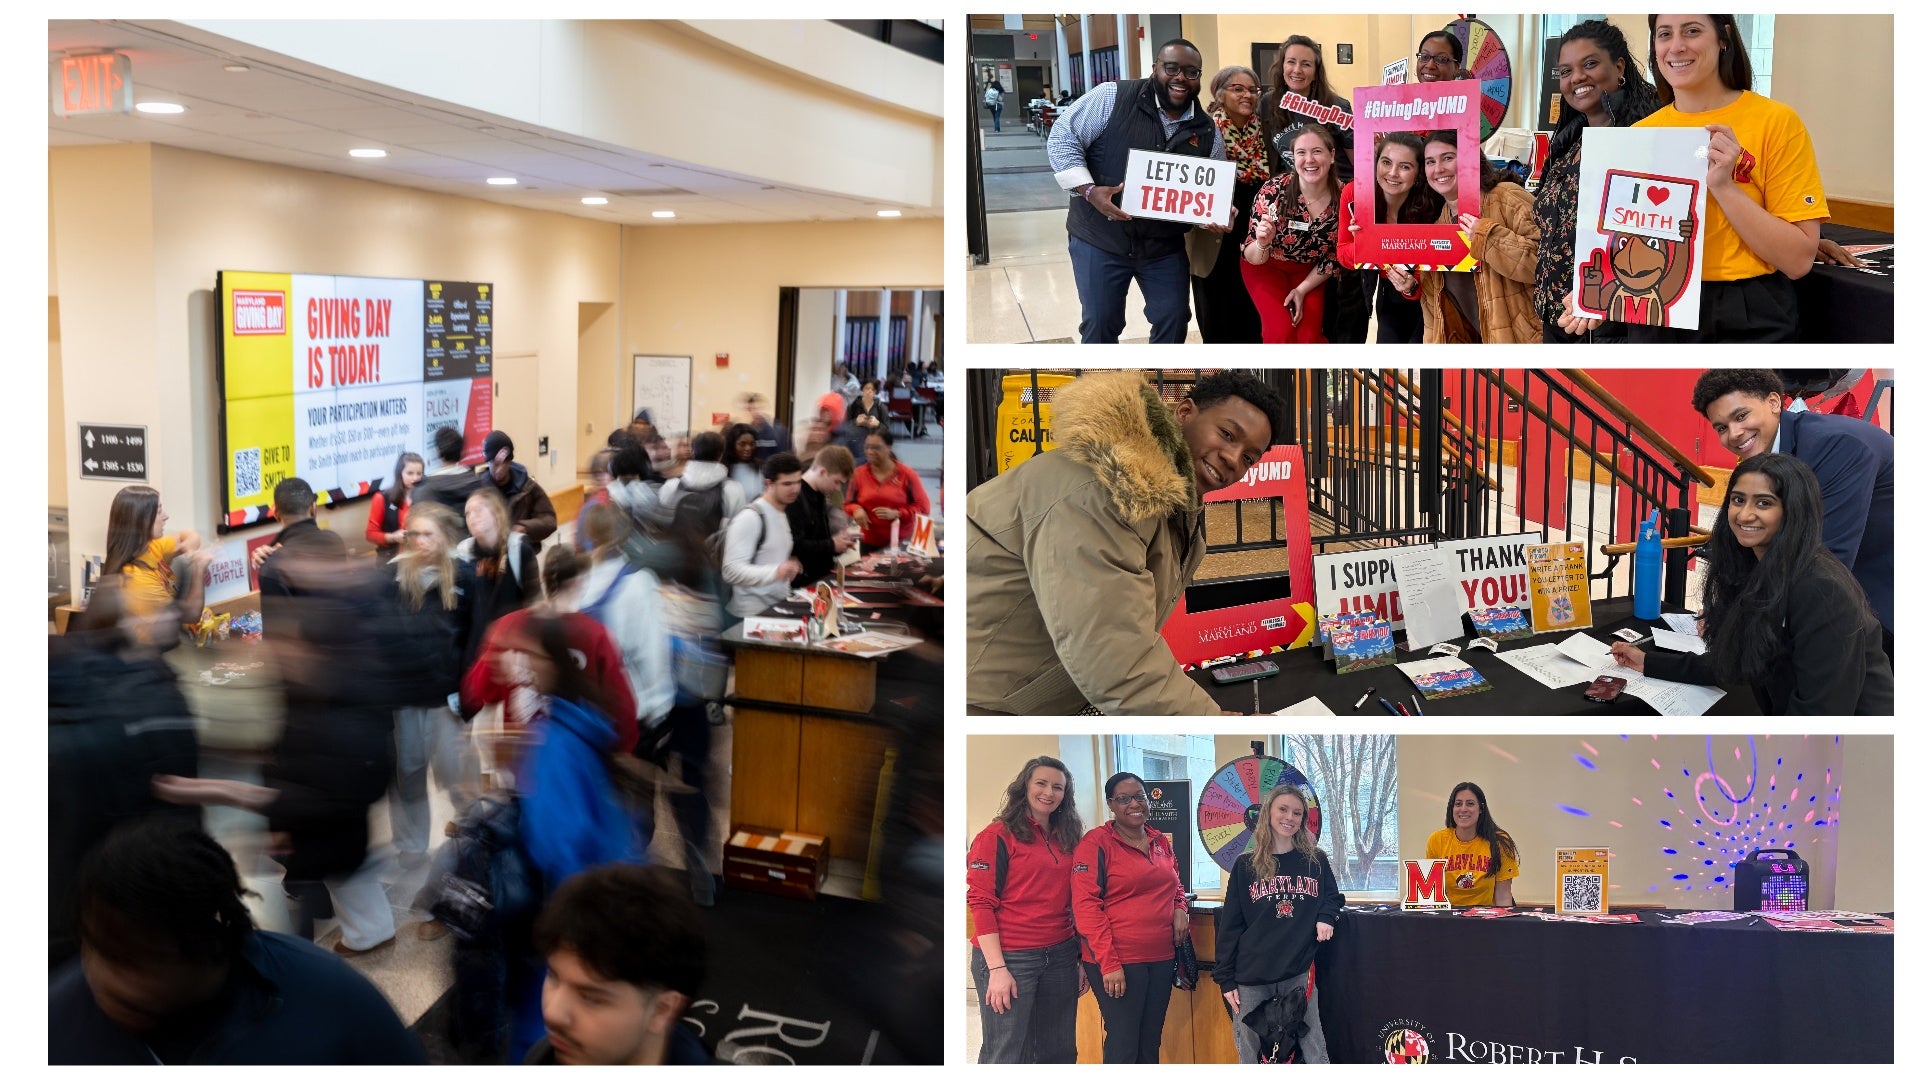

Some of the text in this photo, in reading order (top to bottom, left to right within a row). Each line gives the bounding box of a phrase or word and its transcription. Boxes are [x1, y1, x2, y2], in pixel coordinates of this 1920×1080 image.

[62, 55, 114, 110] EXIT
[1364, 95, 1467, 120] #GivingDayUMD
[1146, 160, 1215, 186] LET'S GO
[1141, 185, 1214, 217] TERPS!
[1632, 183, 1640, 203] I
[1613, 207, 1672, 229] SMITH
[237, 306, 282, 329] GIVING DAY
[308, 297, 392, 339] GIVING DAY
[1624, 296, 1650, 324] M
[308, 346, 323, 388] IS
[328, 344, 380, 386] TODAY!
[308, 398, 407, 427] YOUR PARTICIPATION MATTERS
[101, 434, 118, 445] 1100
[264, 445, 290, 465] GIVE TO
[911, 516, 933, 550] M
[211, 559, 243, 573] FEAR THE
[1456, 544, 1526, 572] THANK
[213, 566, 244, 584] TURTLE
[1331, 565, 1336, 590] I
[1460, 574, 1528, 608] YOU!
[1198, 626, 1258, 644] MARYLAND
[1249, 876, 1318, 903] MARYLAND
[1405, 861, 1448, 903] M
[1378, 1018, 1436, 1043] UNIVERSITY OF
[1446, 1032, 1564, 1064] ROBERT
